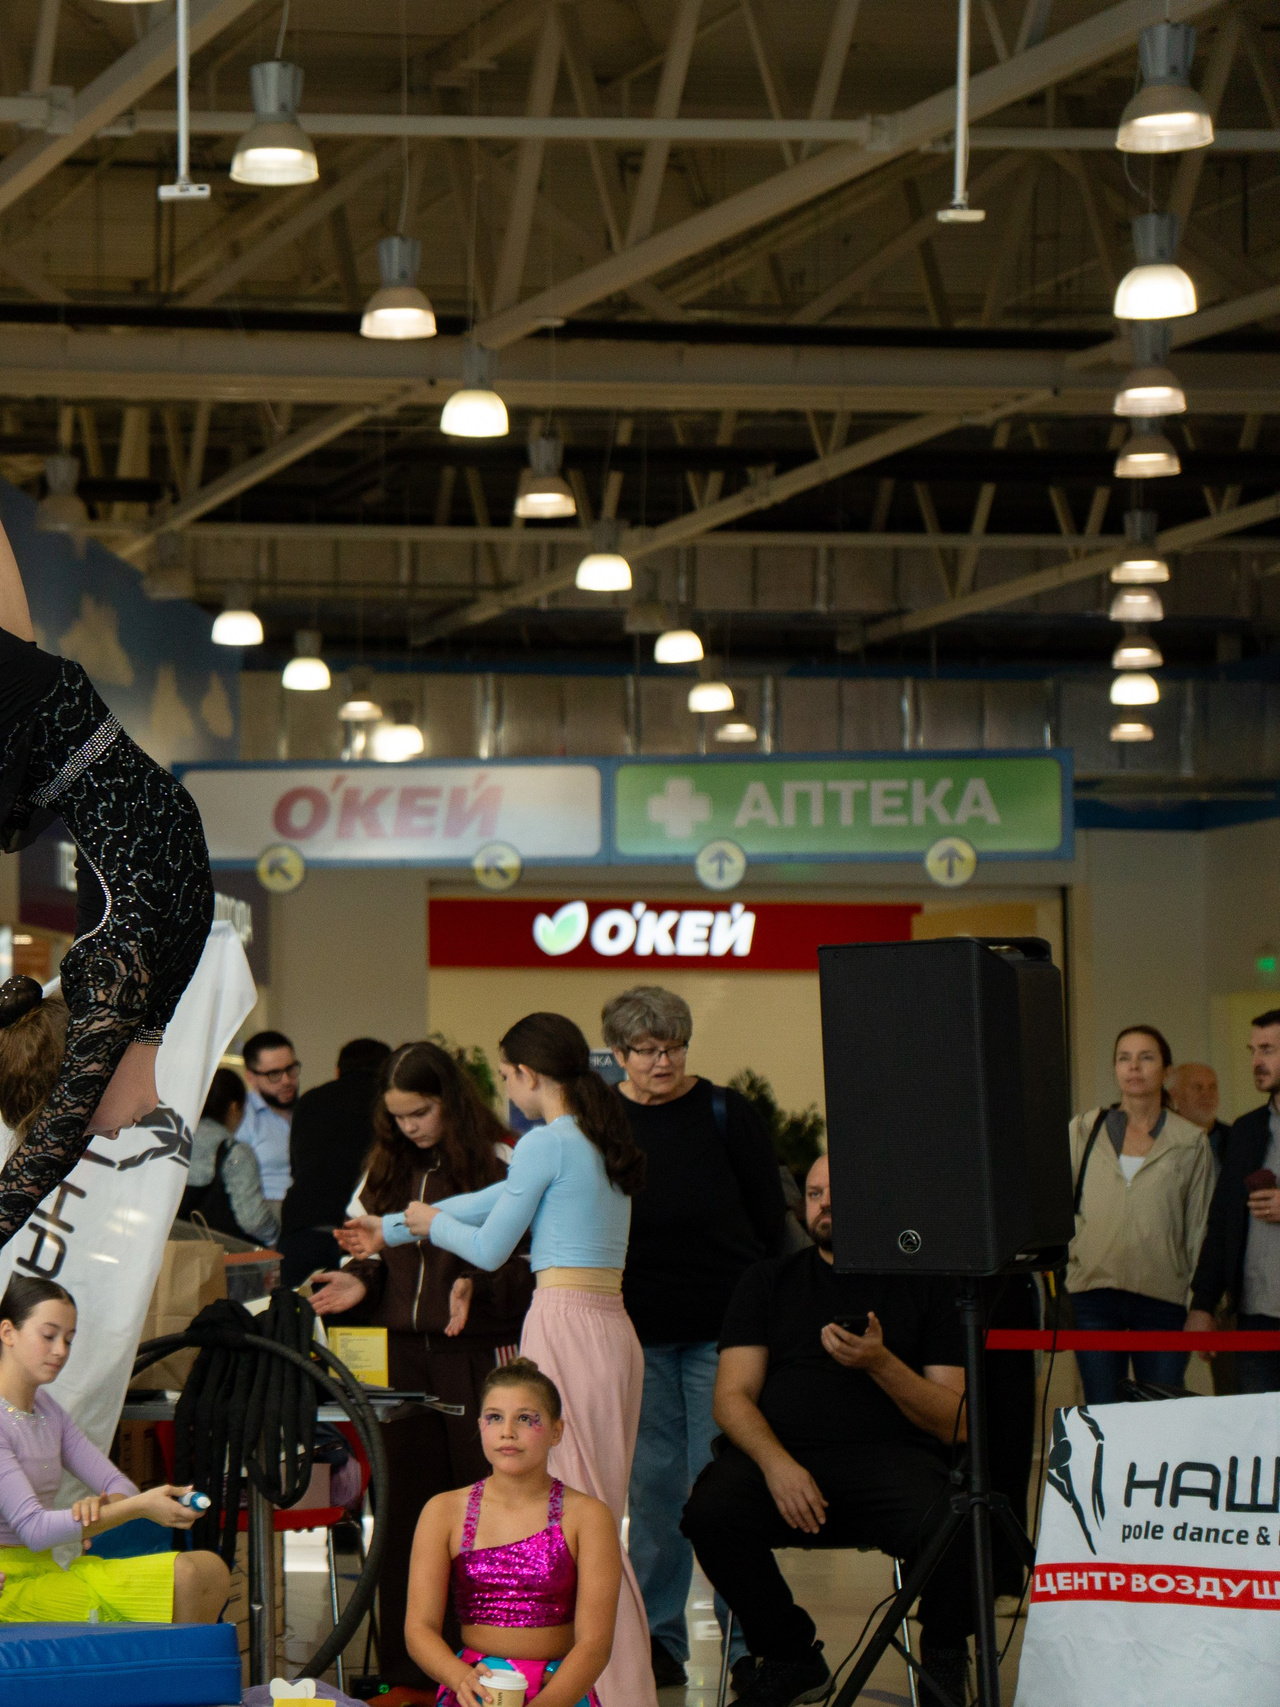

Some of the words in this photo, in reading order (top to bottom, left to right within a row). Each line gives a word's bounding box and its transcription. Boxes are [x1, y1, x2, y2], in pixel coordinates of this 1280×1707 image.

[734, 777, 1001, 828] АПТЕКА
[590, 901, 756, 957] О'КЕЙ
[14, 1179, 87, 1280] НА
[1123, 1455, 1280, 1513] НАШ
[1121, 1520, 1164, 1543] pole
[1173, 1522, 1249, 1546] dance
[1256, 1526, 1271, 1546] &
[1034, 1571, 1126, 1595] ЦЕНТР
